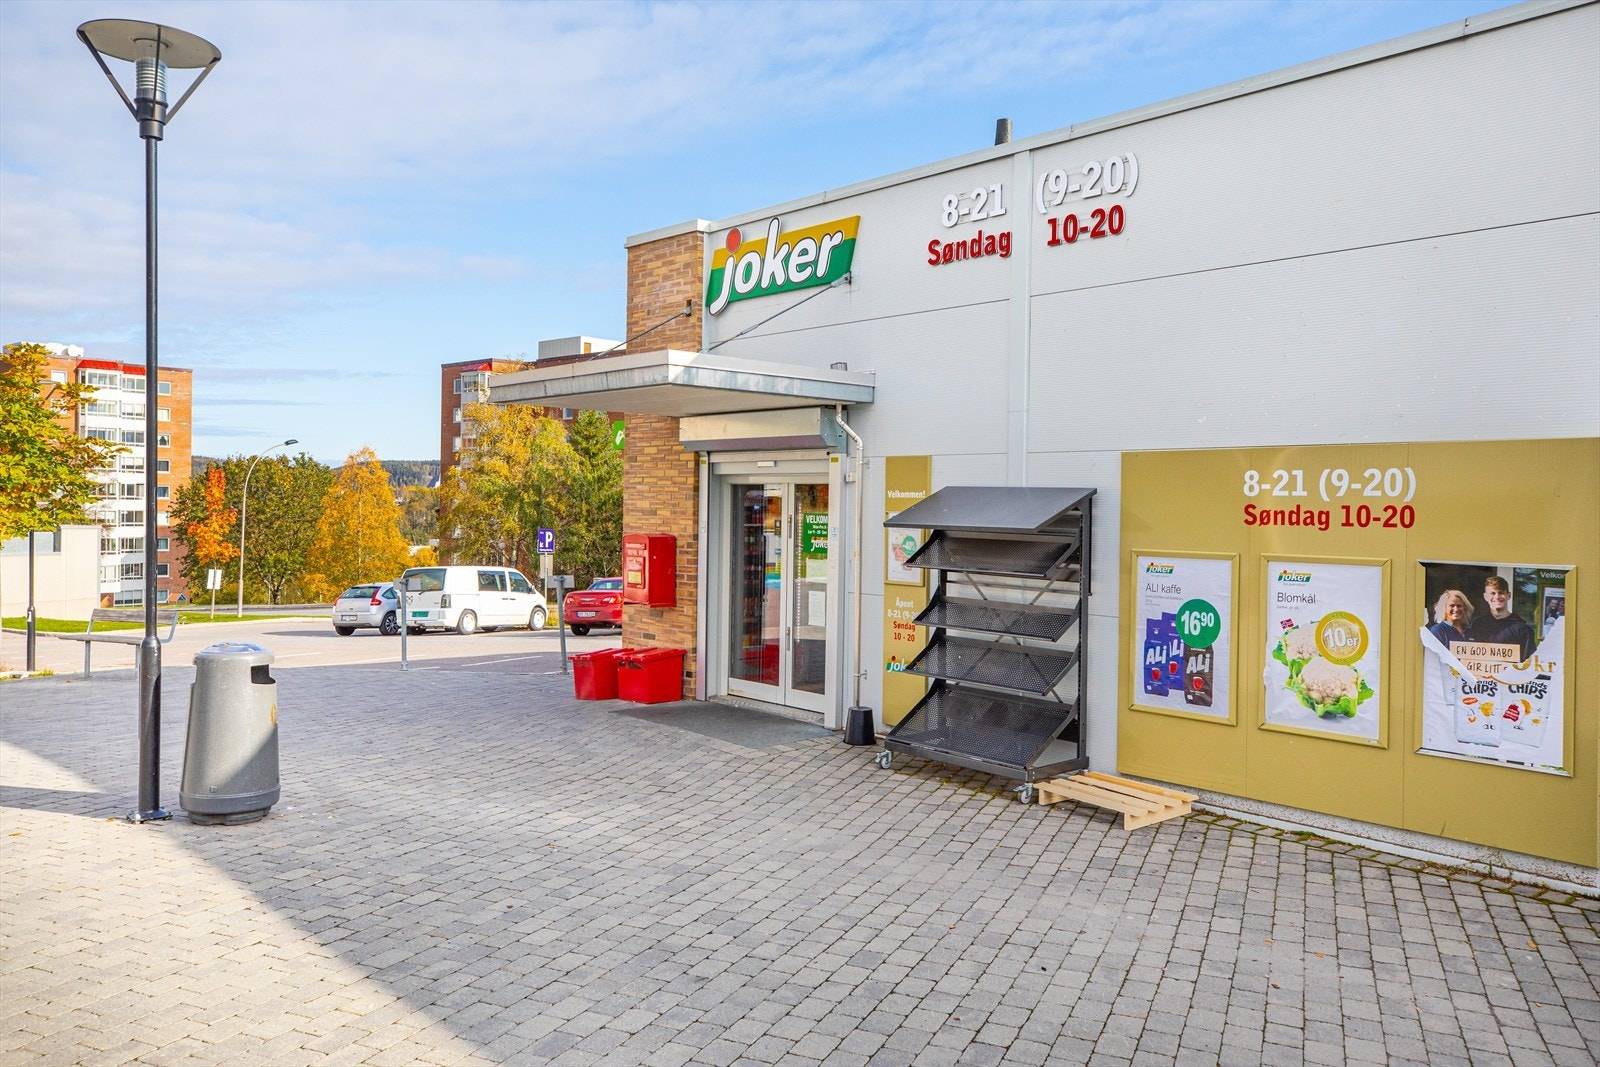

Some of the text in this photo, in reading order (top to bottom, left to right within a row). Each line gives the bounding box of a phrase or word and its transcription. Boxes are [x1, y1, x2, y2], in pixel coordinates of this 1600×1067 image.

[941, 151, 1139, 228] 8-21 (9-20)
[927, 204, 1126, 266] Søndag 10-20
[709, 217, 844, 316] joker
[1243, 467, 1417, 502] 8-21 (9-20)
[887, 490, 926, 498] Velkommen!
[1243, 504, 1416, 532] Søndag 10-20
[545, 531, 553, 548] P
[1279, 570, 1310, 584] joker
[1145, 582, 1182, 595] ALI kaffe
[1277, 591, 1316, 604] Blomkål
[893, 621, 916, 632] Søndag
[1456, 645, 1513, 658] EN GOD NABO
[1466, 661, 1482, 672] GIR
[1508, 684, 1547, 699] CHIPS
